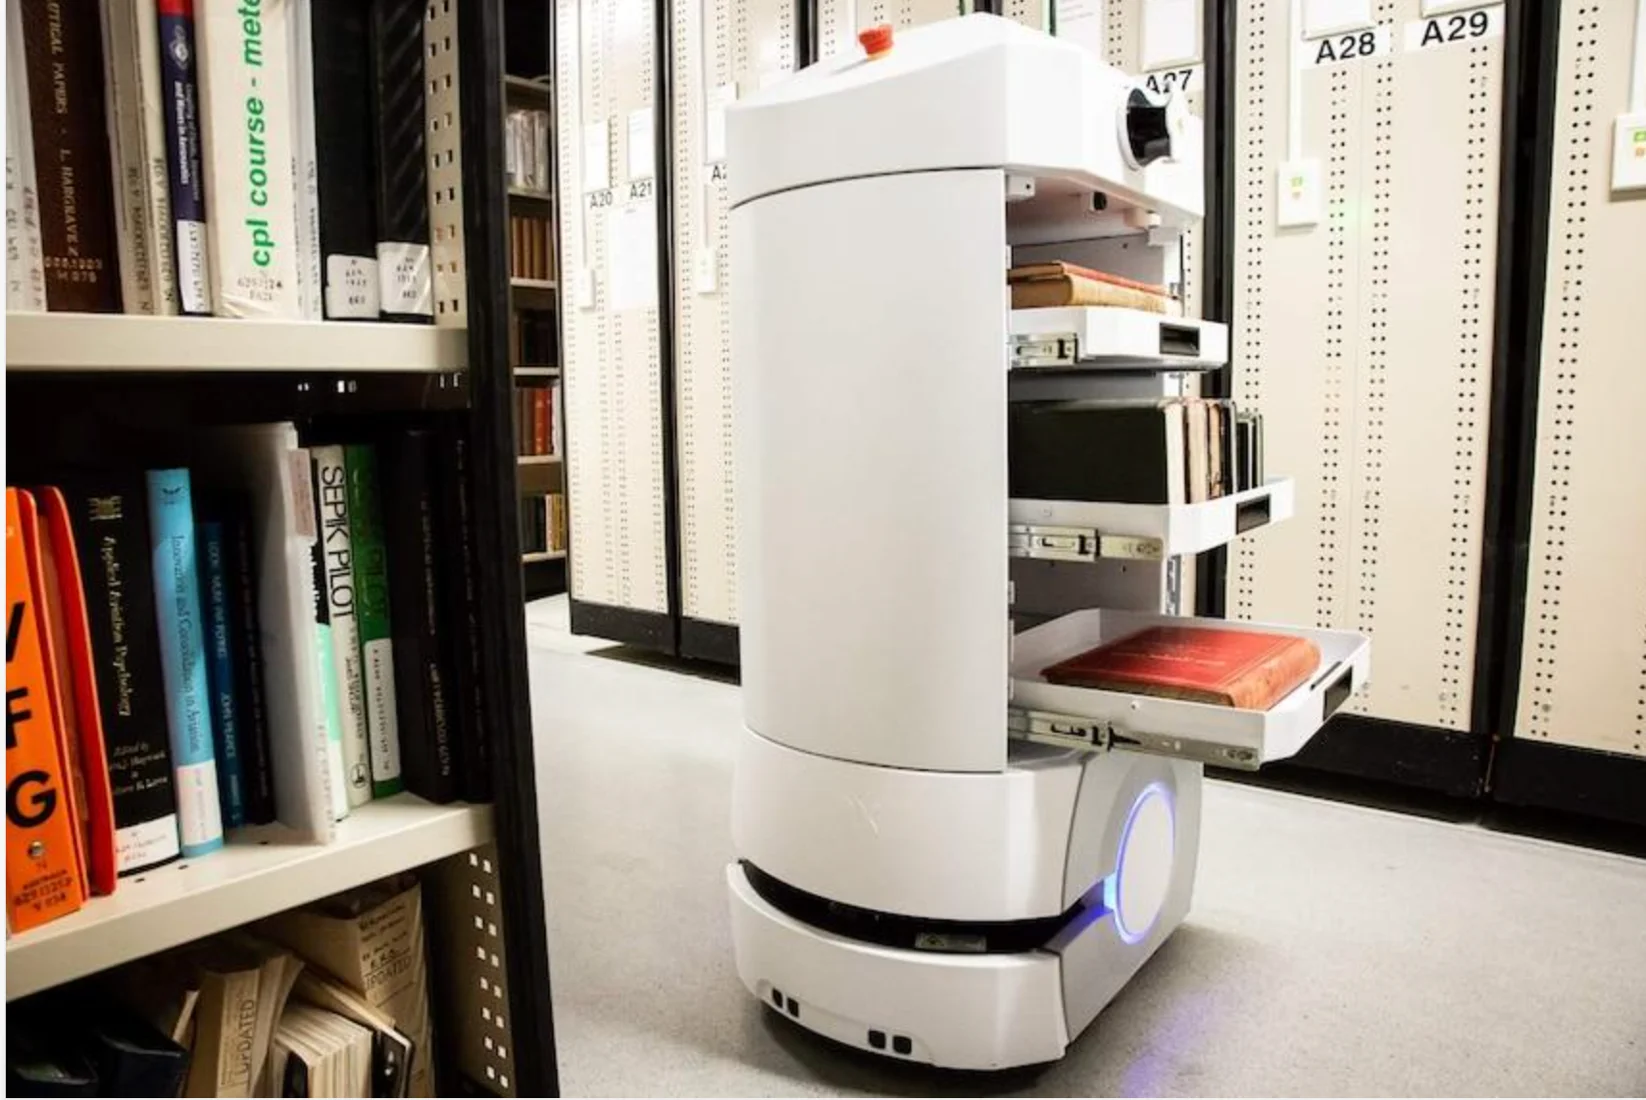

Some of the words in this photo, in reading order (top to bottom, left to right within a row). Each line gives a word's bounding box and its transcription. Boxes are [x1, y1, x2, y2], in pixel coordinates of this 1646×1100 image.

[1315, 32, 1375, 64] A28
[1421, 11, 1488, 46] A29
[1146, 69, 1193, 94] A27
[246, 96, 268, 208] course
[589, 191, 613, 209] A20
[629, 183, 653, 199] A21
[245, 218, 275, 267] cpl
[321, 466, 349, 543] SEPIK
[171, 534, 186, 594] Innovation
[328, 549, 356, 619] PILOT
[101, 536, 121, 587] Applied
[113, 645, 133, 716] Psychology
[176, 597, 191, 617] and
[178, 618, 197, 693] Consolidation
[236, 999, 255, 1075] UPDATED
